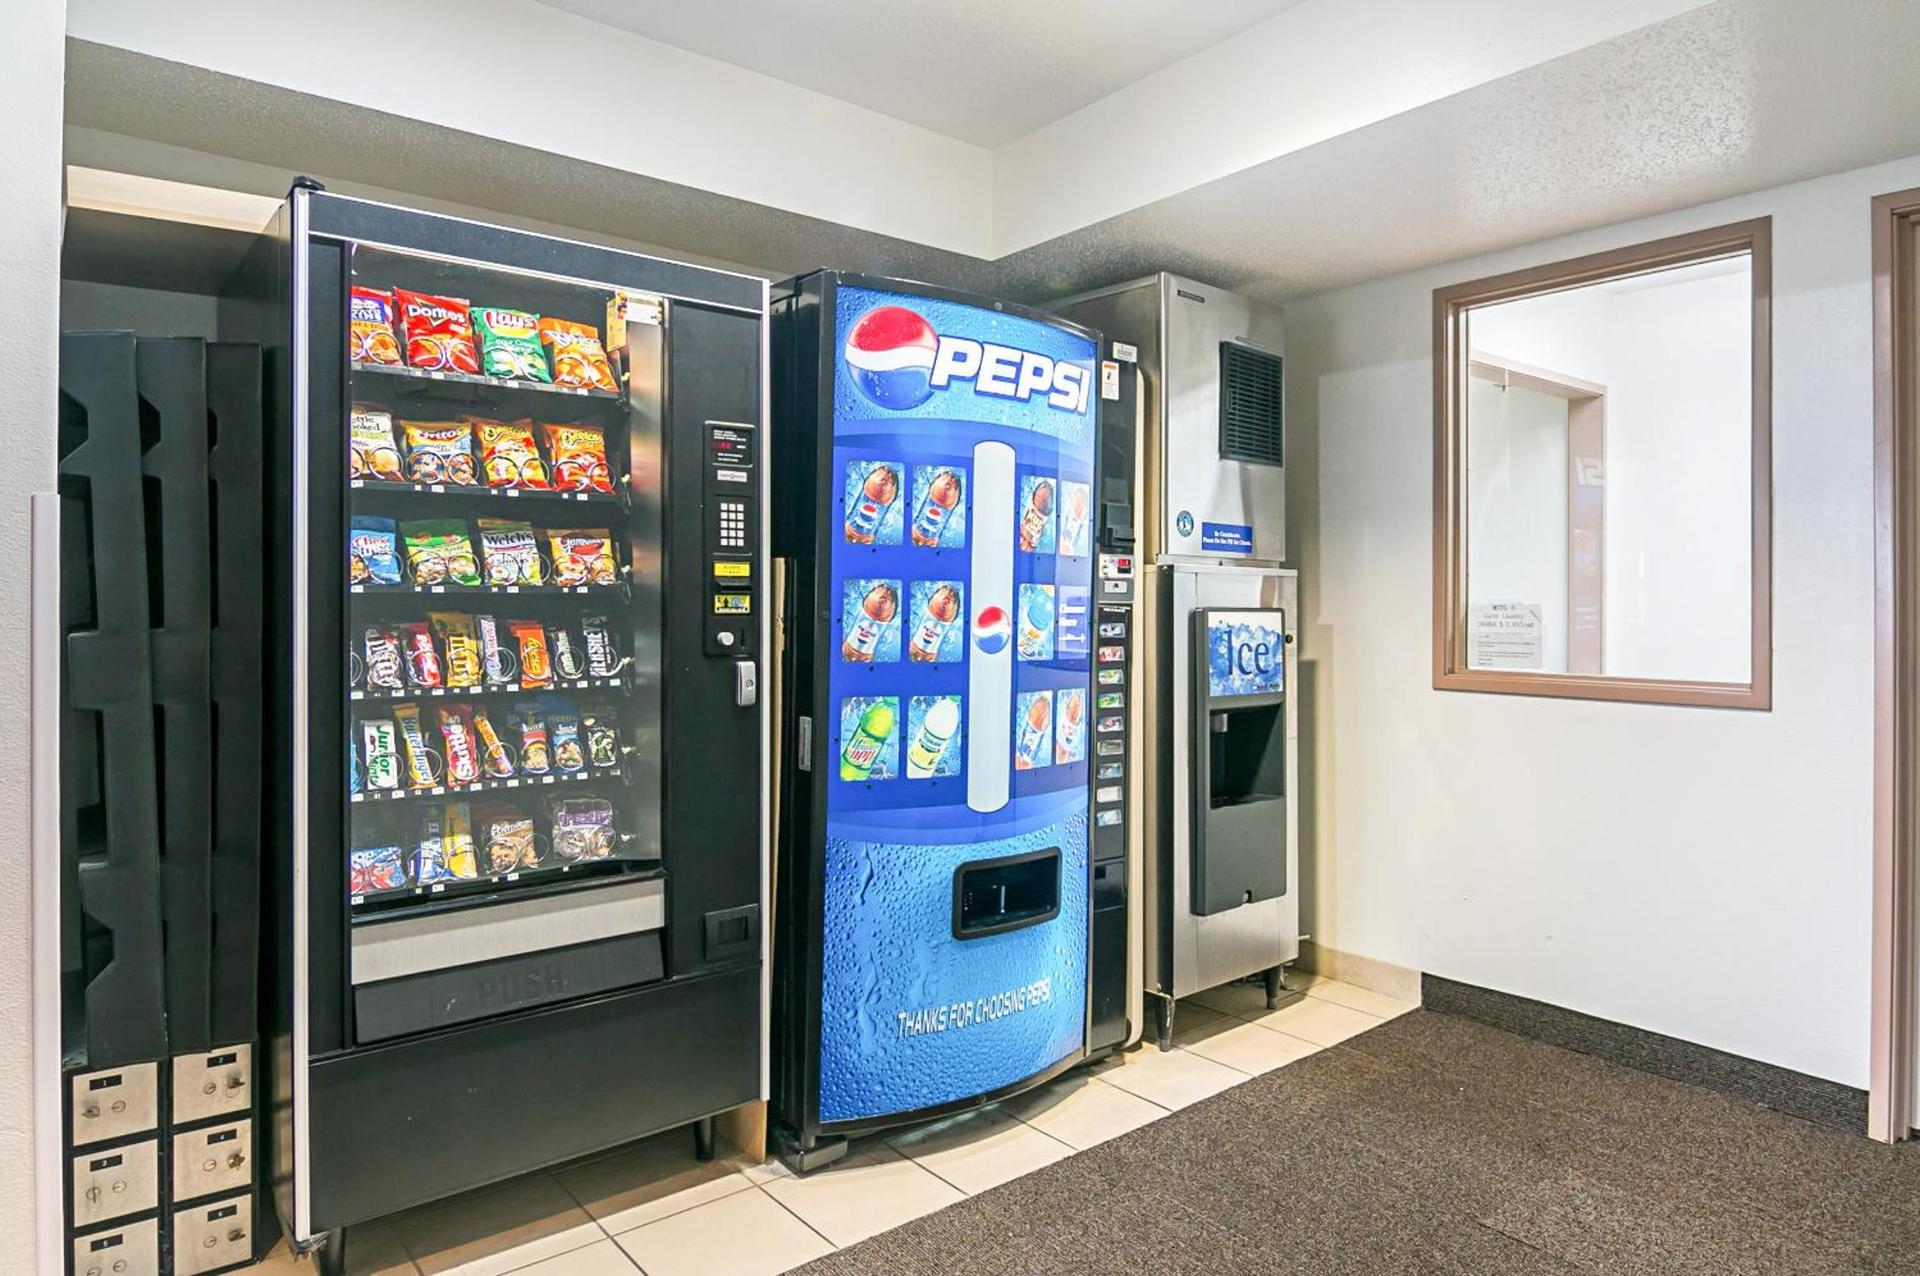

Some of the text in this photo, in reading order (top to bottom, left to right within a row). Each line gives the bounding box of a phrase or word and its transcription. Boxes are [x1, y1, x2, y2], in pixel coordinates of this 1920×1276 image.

[407, 304, 466, 323] Doritos
[929, 335, 1091, 416] PEPSI
[483, 531, 533, 546] Welch's
[376, 726, 391, 776] Junior
[898, 1005, 947, 1037] THANKS
[950, 1001, 974, 1028] FOR
[975, 987, 1026, 1024] CHOOSING
